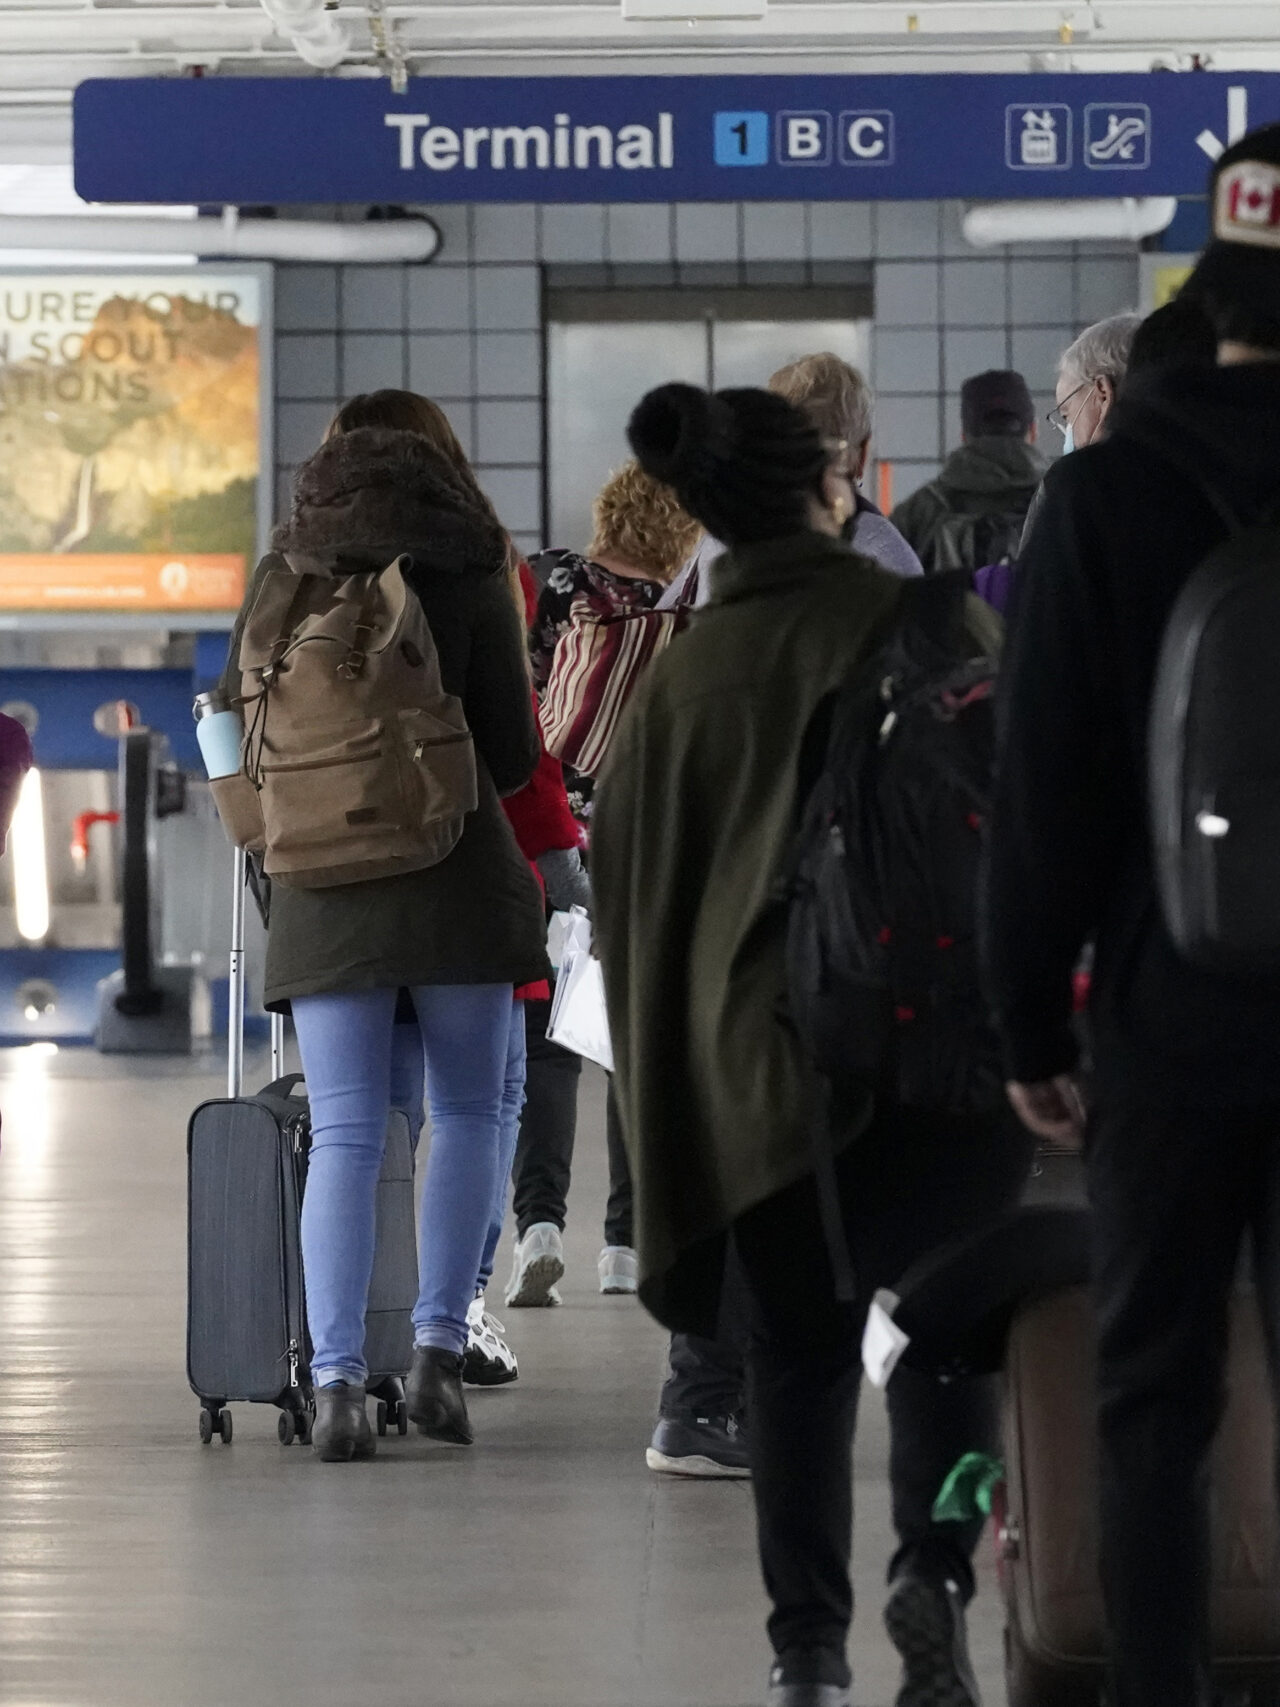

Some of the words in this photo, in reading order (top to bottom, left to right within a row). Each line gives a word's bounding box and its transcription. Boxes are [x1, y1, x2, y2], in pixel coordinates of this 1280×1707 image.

[384, 112, 675, 171] Terminal
[731, 120, 748, 157] 1
[787, 117, 821, 159] B
[847, 116, 885, 158] C
[106, 290, 241, 324] YOUR
[29, 330, 184, 364] SCOUT
